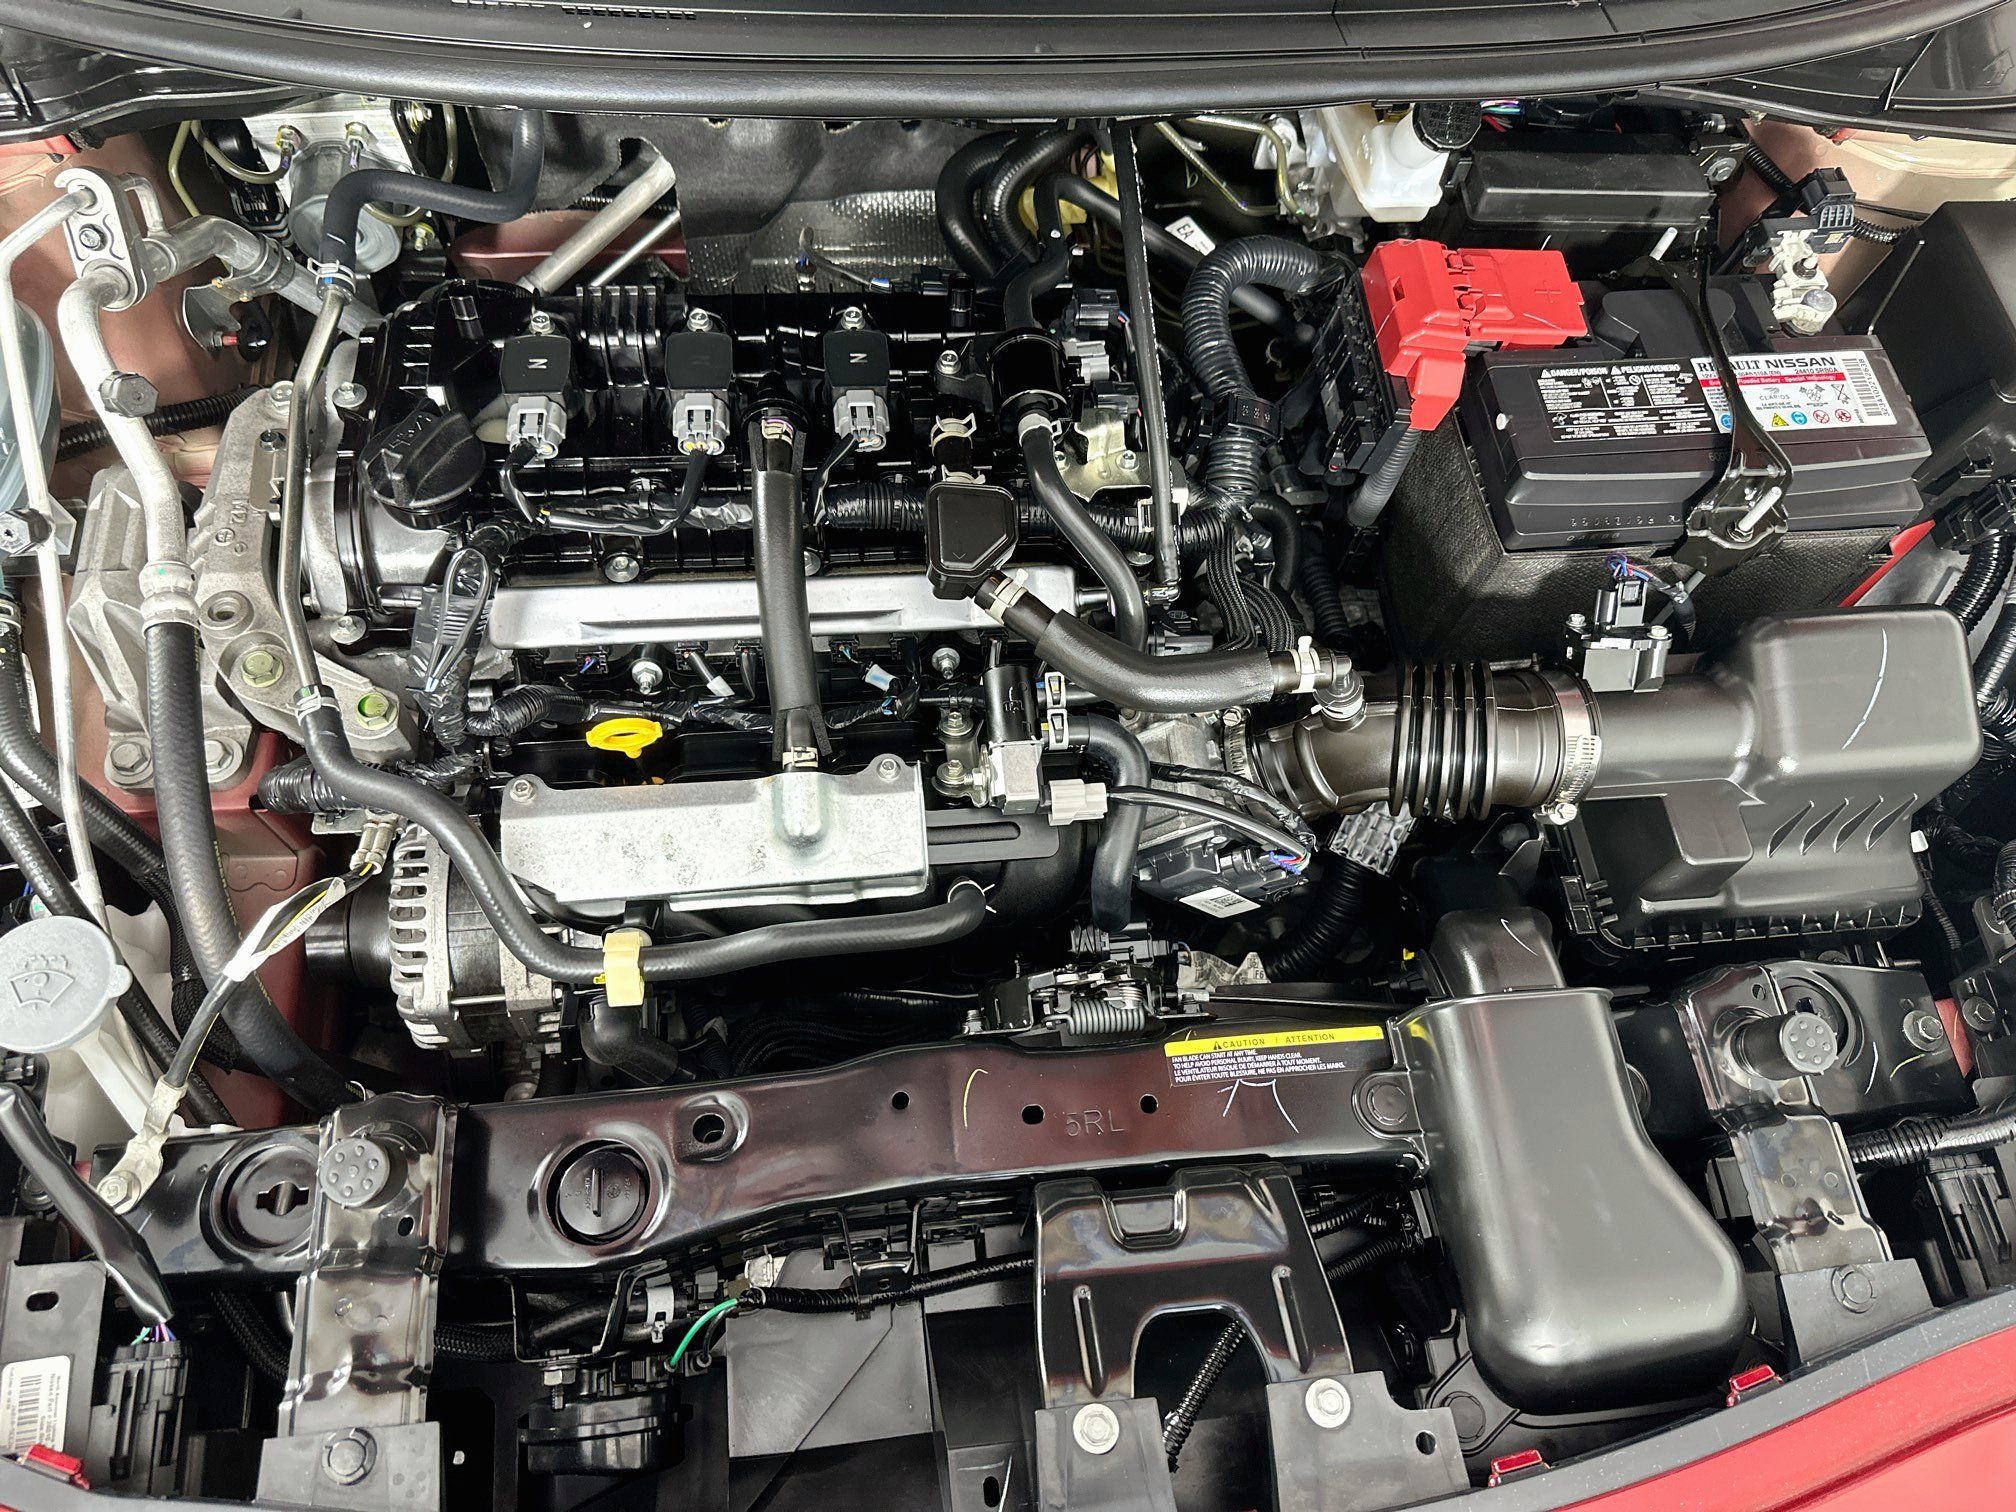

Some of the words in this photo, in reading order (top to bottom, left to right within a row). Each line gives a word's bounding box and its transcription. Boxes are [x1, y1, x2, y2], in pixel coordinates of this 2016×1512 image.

[1176, 223, 1194, 240] EA
[1620, 364, 1680, 373] PELIGRO/VENENO
[1696, 360, 1760, 372] RAULT
[1765, 357, 1836, 368] NISSAN
[1550, 367, 1608, 377] DANGER/POISON
[1223, 1038, 1265, 1048] CAUTION
[1286, 1034, 1335, 1043] ATTENTION
[1182, 1066, 1217, 1075] VENTILATEUR
[1247, 1060, 1276, 1068] DÉMARRER
[1192, 1073, 1210, 1081] ÉVITER
[1230, 1069, 1257, 1078] BLESSURE,
[1066, 1109, 1124, 1136] 5RL
